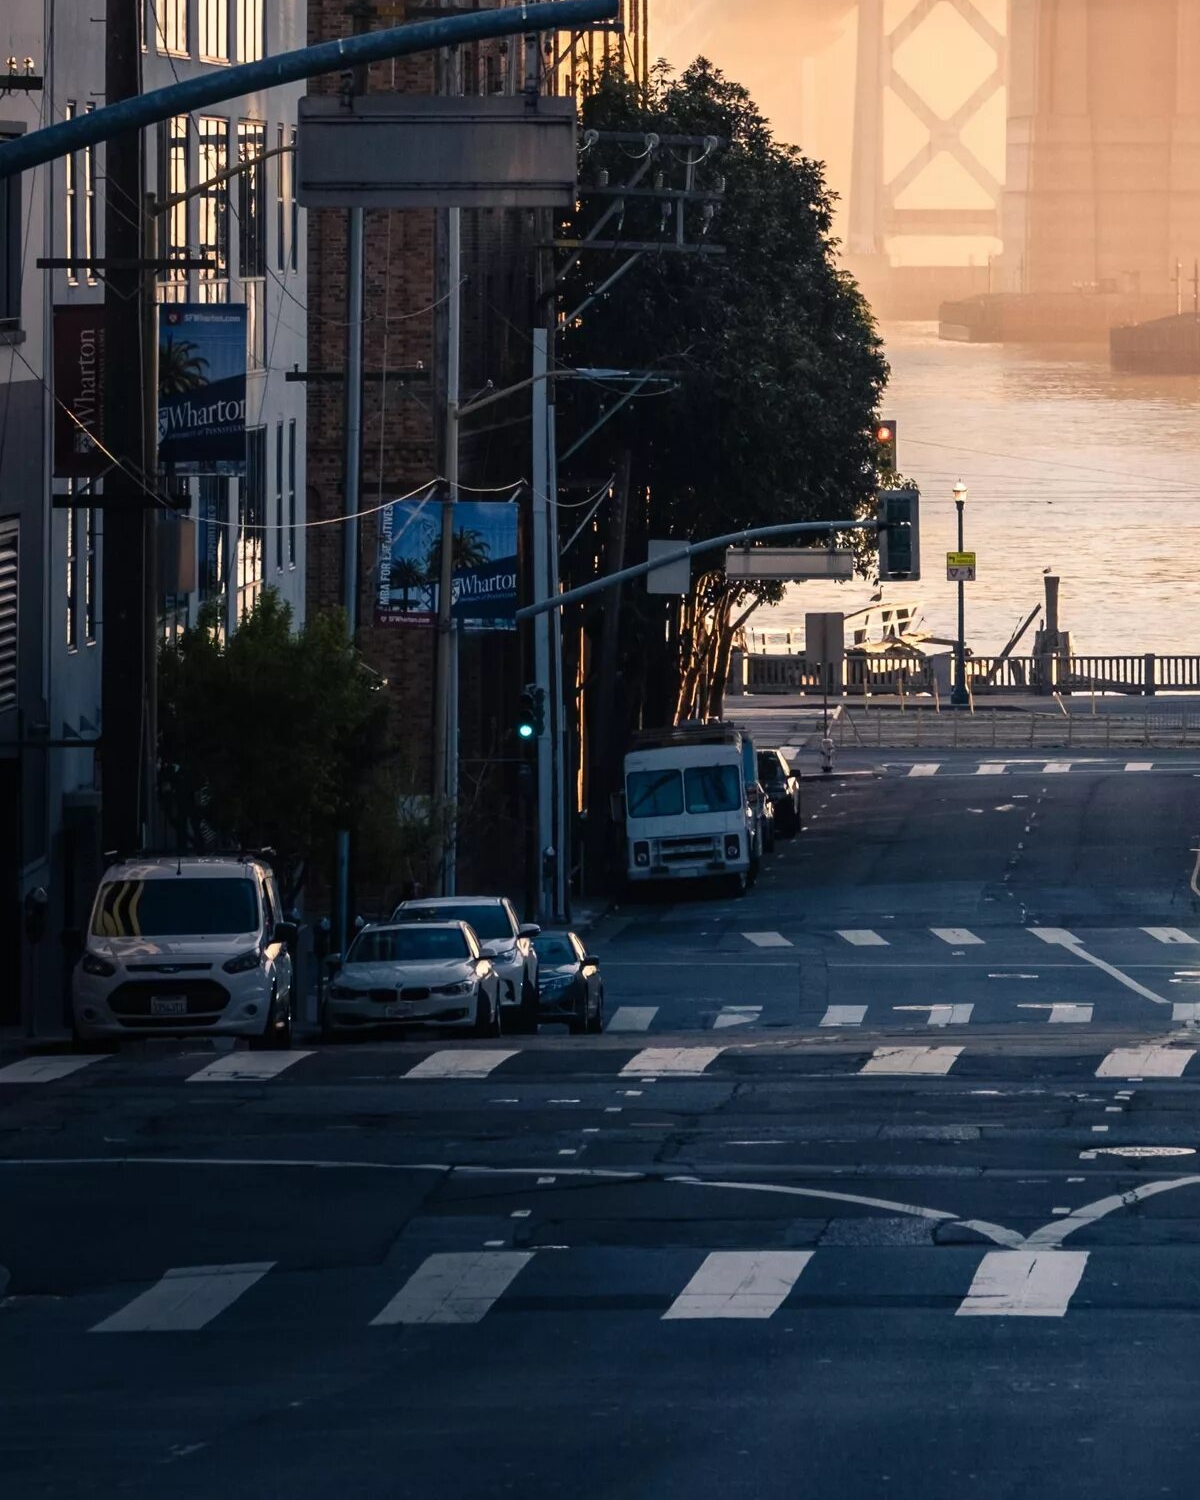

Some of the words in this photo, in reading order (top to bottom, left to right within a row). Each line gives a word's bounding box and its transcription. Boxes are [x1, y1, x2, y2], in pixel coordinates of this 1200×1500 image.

[73, 328, 96, 429] Wharton
[381, 563, 391, 581] FOR
[379, 583, 390, 605] MBA
